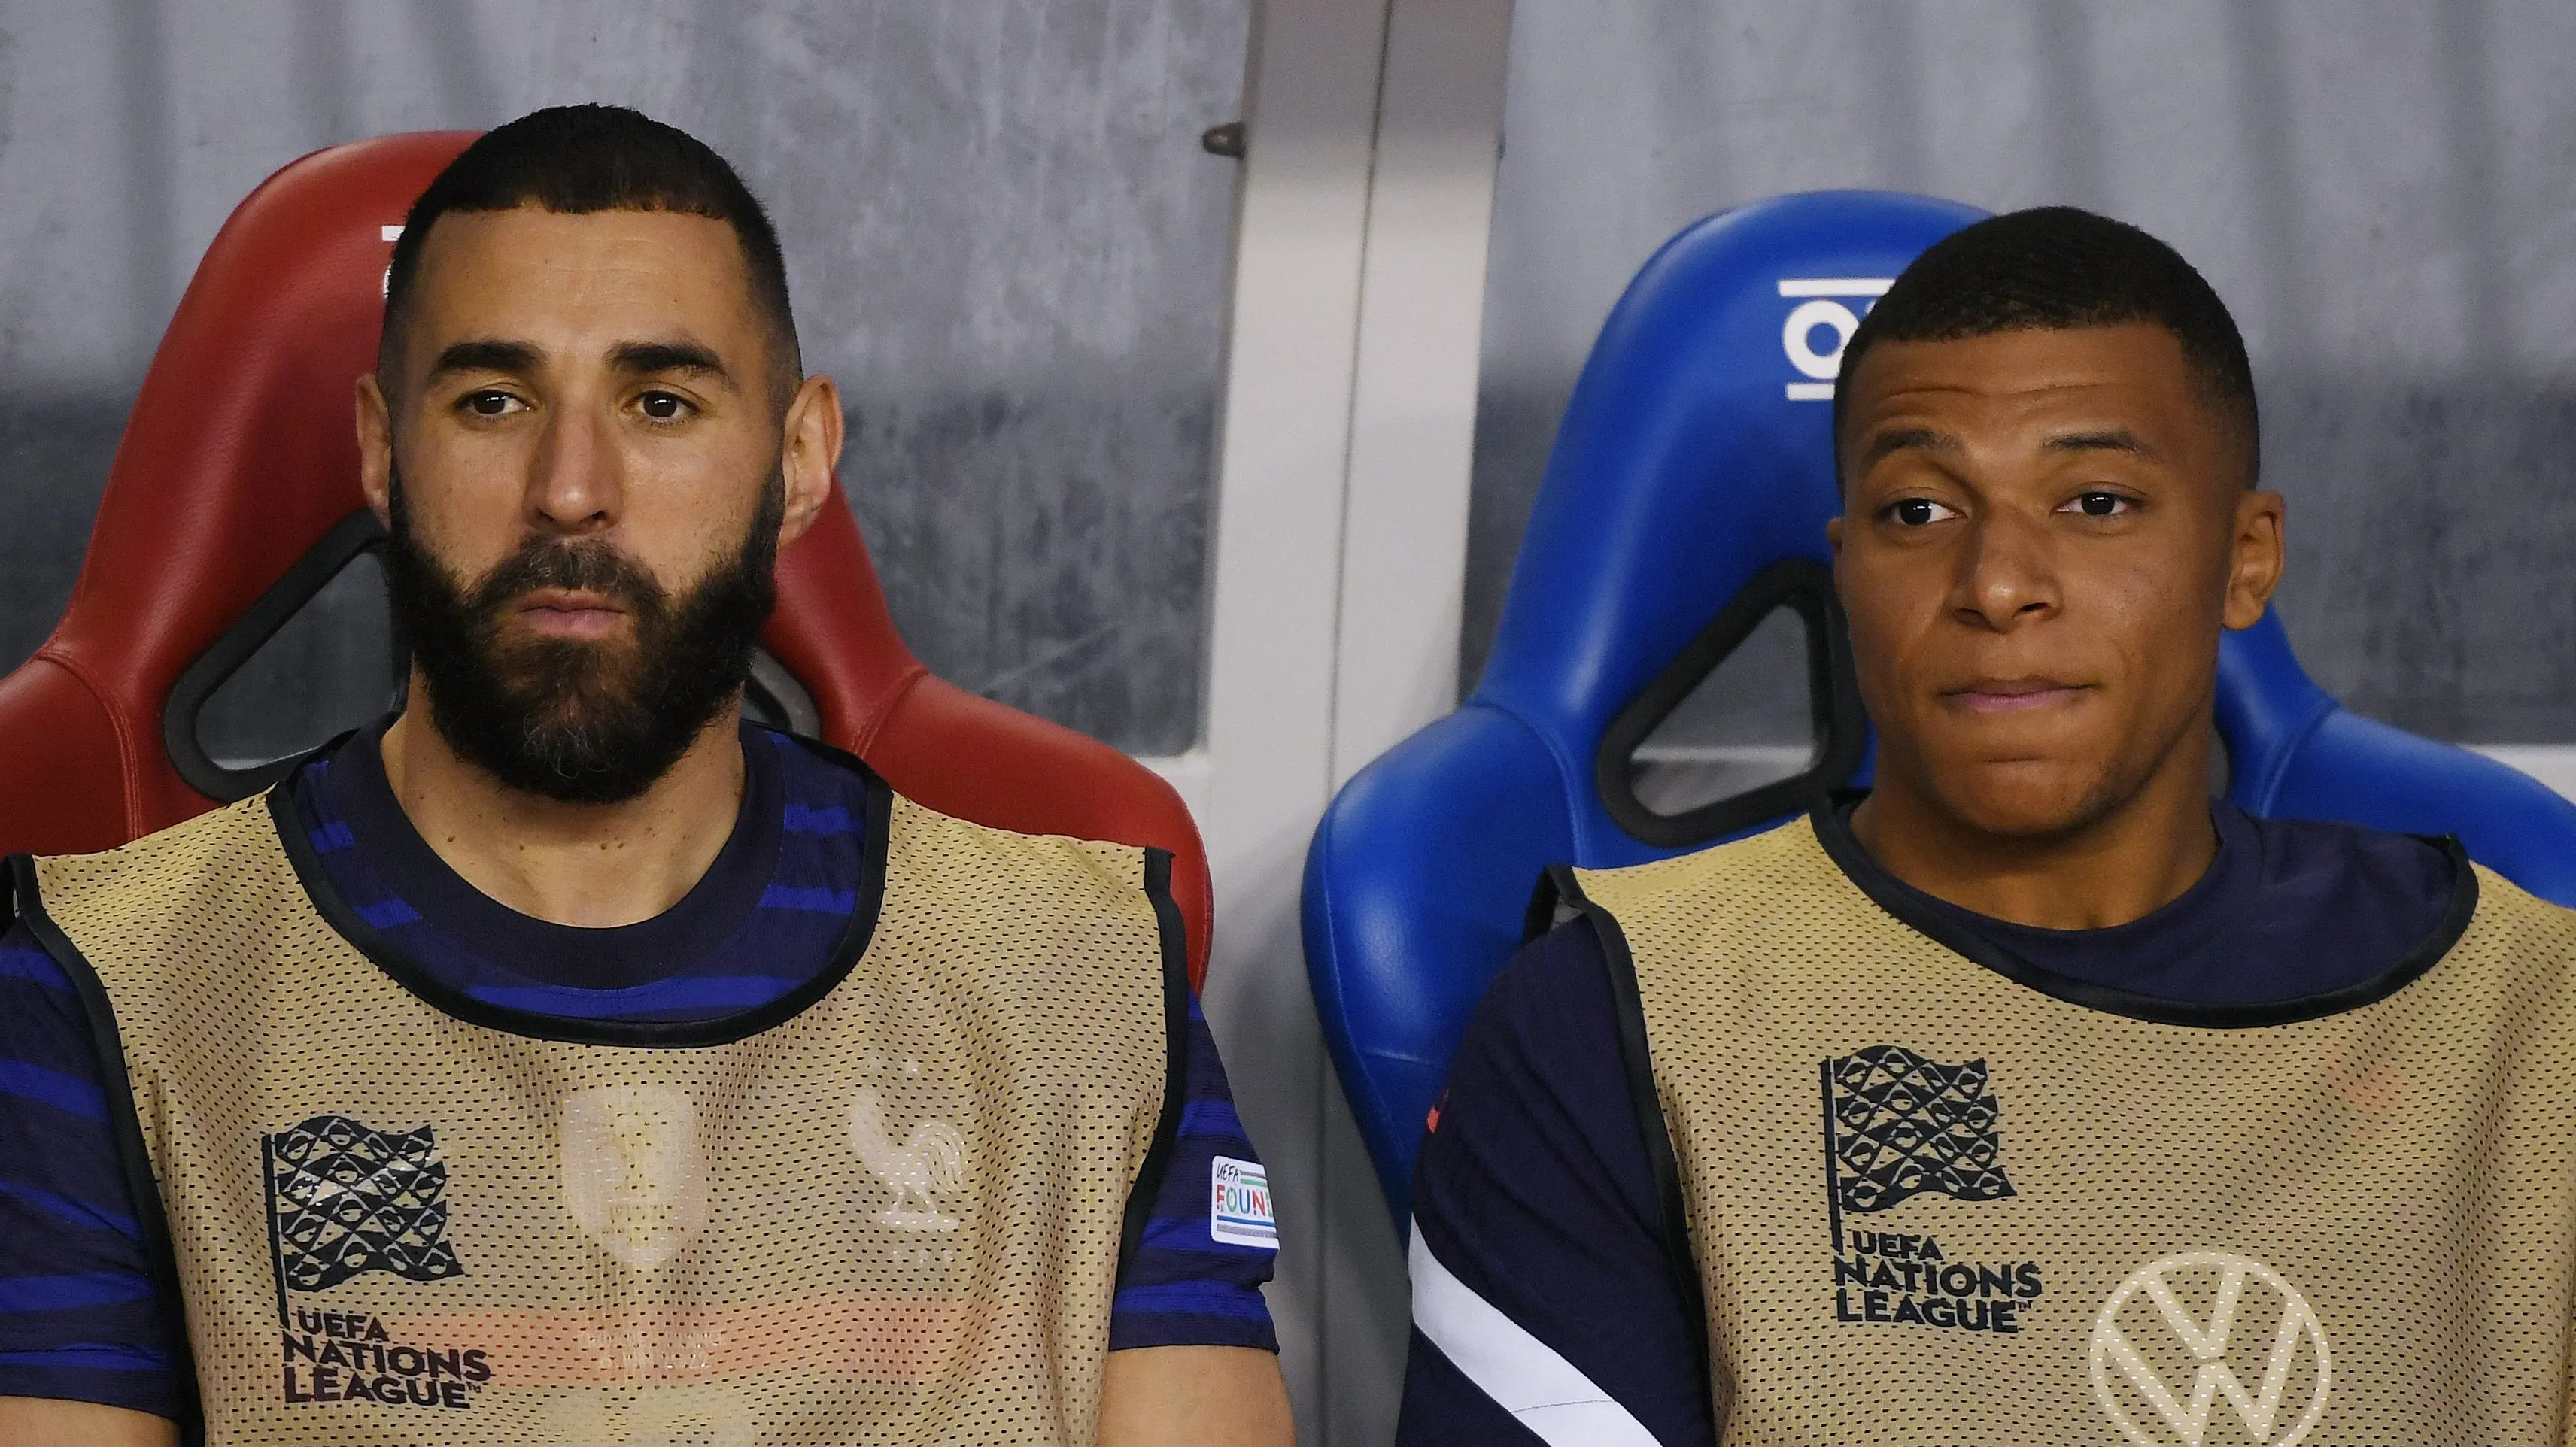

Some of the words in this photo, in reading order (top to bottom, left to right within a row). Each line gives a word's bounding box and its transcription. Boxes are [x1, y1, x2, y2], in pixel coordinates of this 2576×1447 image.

[1217, 1163, 1239, 1182] UEFA
[1852, 1230, 1944, 1260] UEFA
[1833, 1254, 2043, 1298] NATIONS
[297, 1309, 390, 1342] UEFA
[282, 1330, 491, 1382] NATIONS
